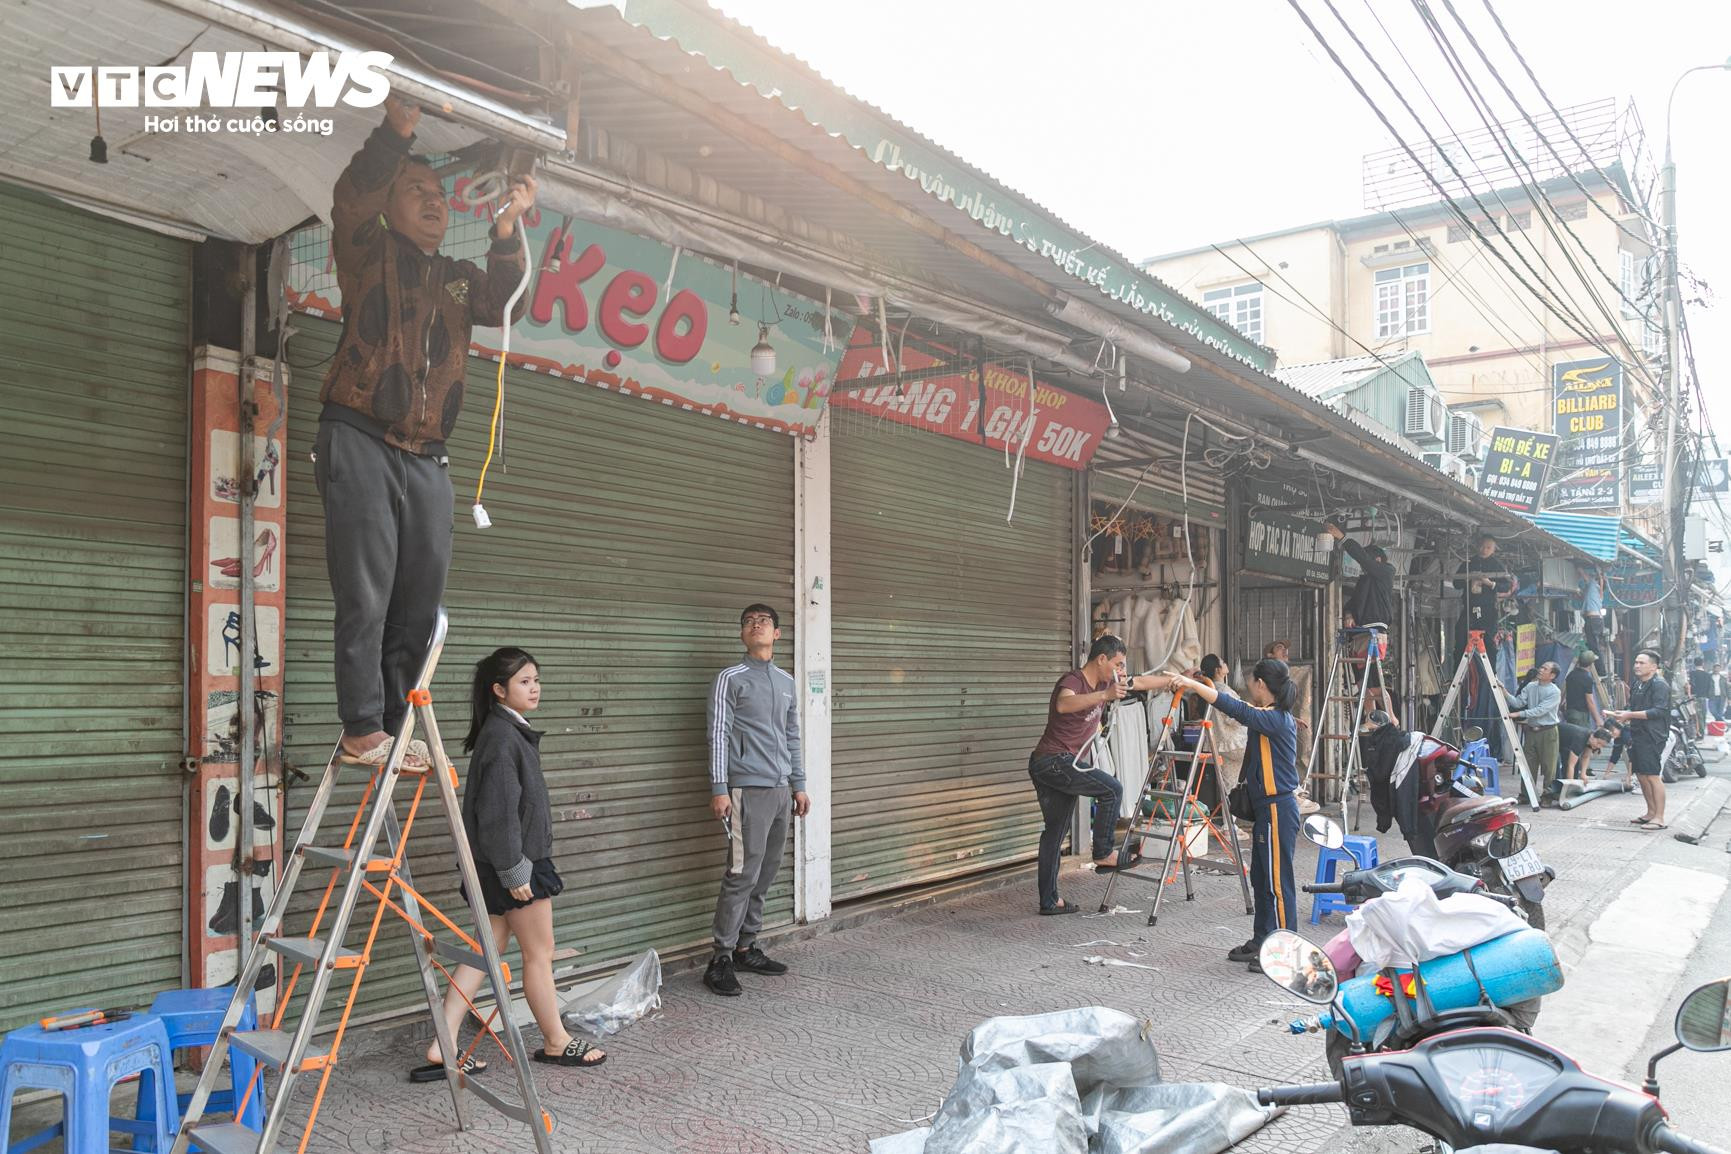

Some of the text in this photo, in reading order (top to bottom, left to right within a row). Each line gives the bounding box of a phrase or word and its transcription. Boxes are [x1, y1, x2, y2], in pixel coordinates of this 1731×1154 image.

[985, 368, 1029, 397] KHOA
[1557, 394, 1617, 414] BILLIARD
[1570, 415, 1604, 433] CLUB
[1037, 421, 1092, 462] 50K
[1533, 442, 1551, 460] XE
[1499, 458, 1514, 474] BI
[1521, 462, 1532, 478] A
